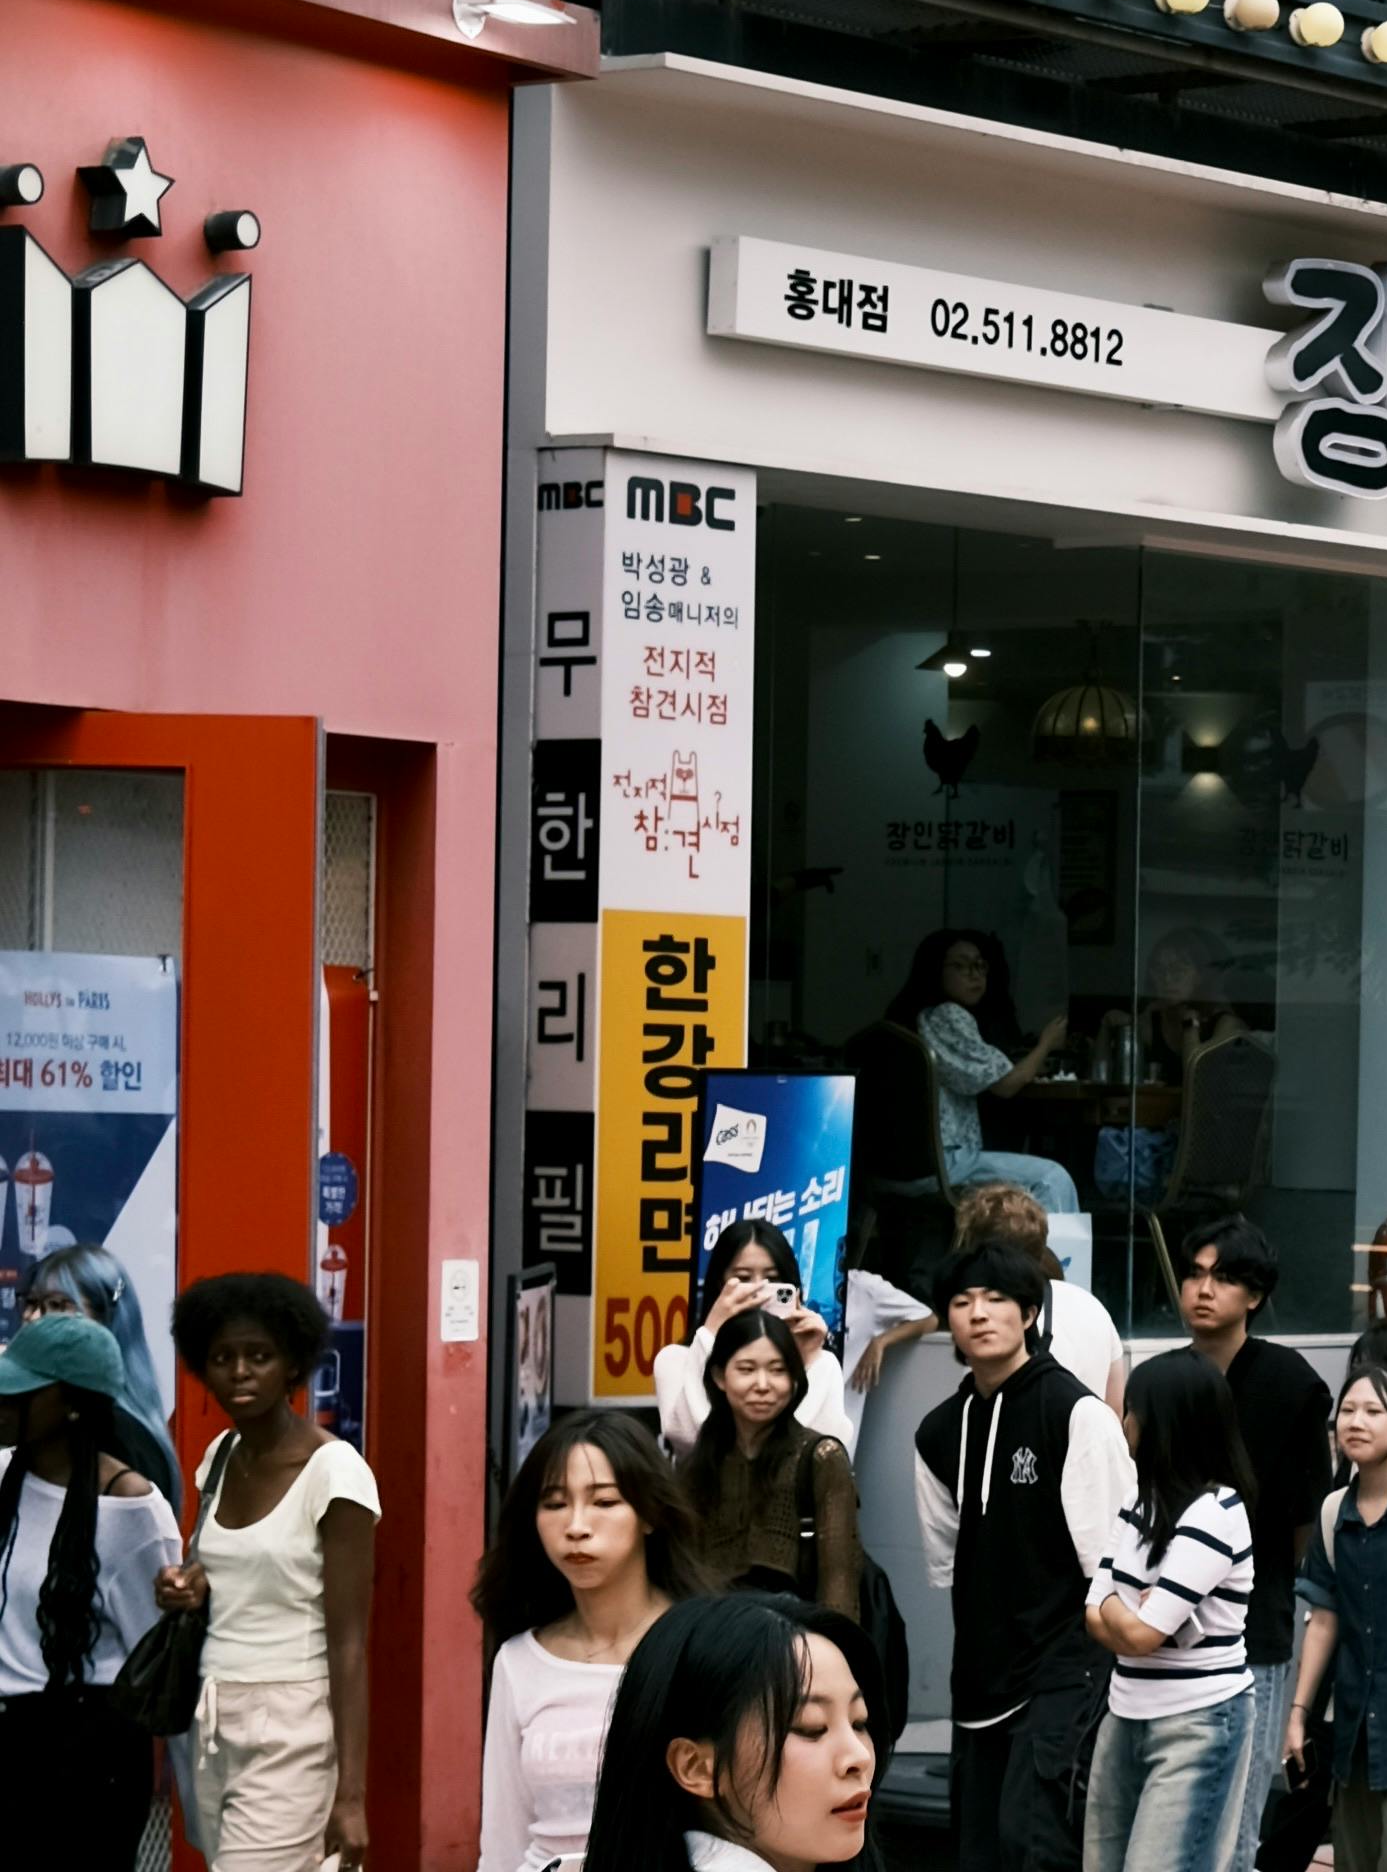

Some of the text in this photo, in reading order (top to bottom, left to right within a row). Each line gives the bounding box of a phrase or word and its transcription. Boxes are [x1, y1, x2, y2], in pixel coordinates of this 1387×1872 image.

[782, 268, 1125, 367] 홍대점 02.511.8812
[537, 480, 605, 513] MBC
[626, 475, 737, 532] MBC
[621, 551, 712, 588] 박성광 &
[620, 589, 740, 630] 임송매니저의
[642, 644, 717, 683] 전지적
[628, 685, 729, 727] 참견시점
[39, 1059, 142, 1091] 61% 할인
[798, 1165, 847, 1217] 소리
